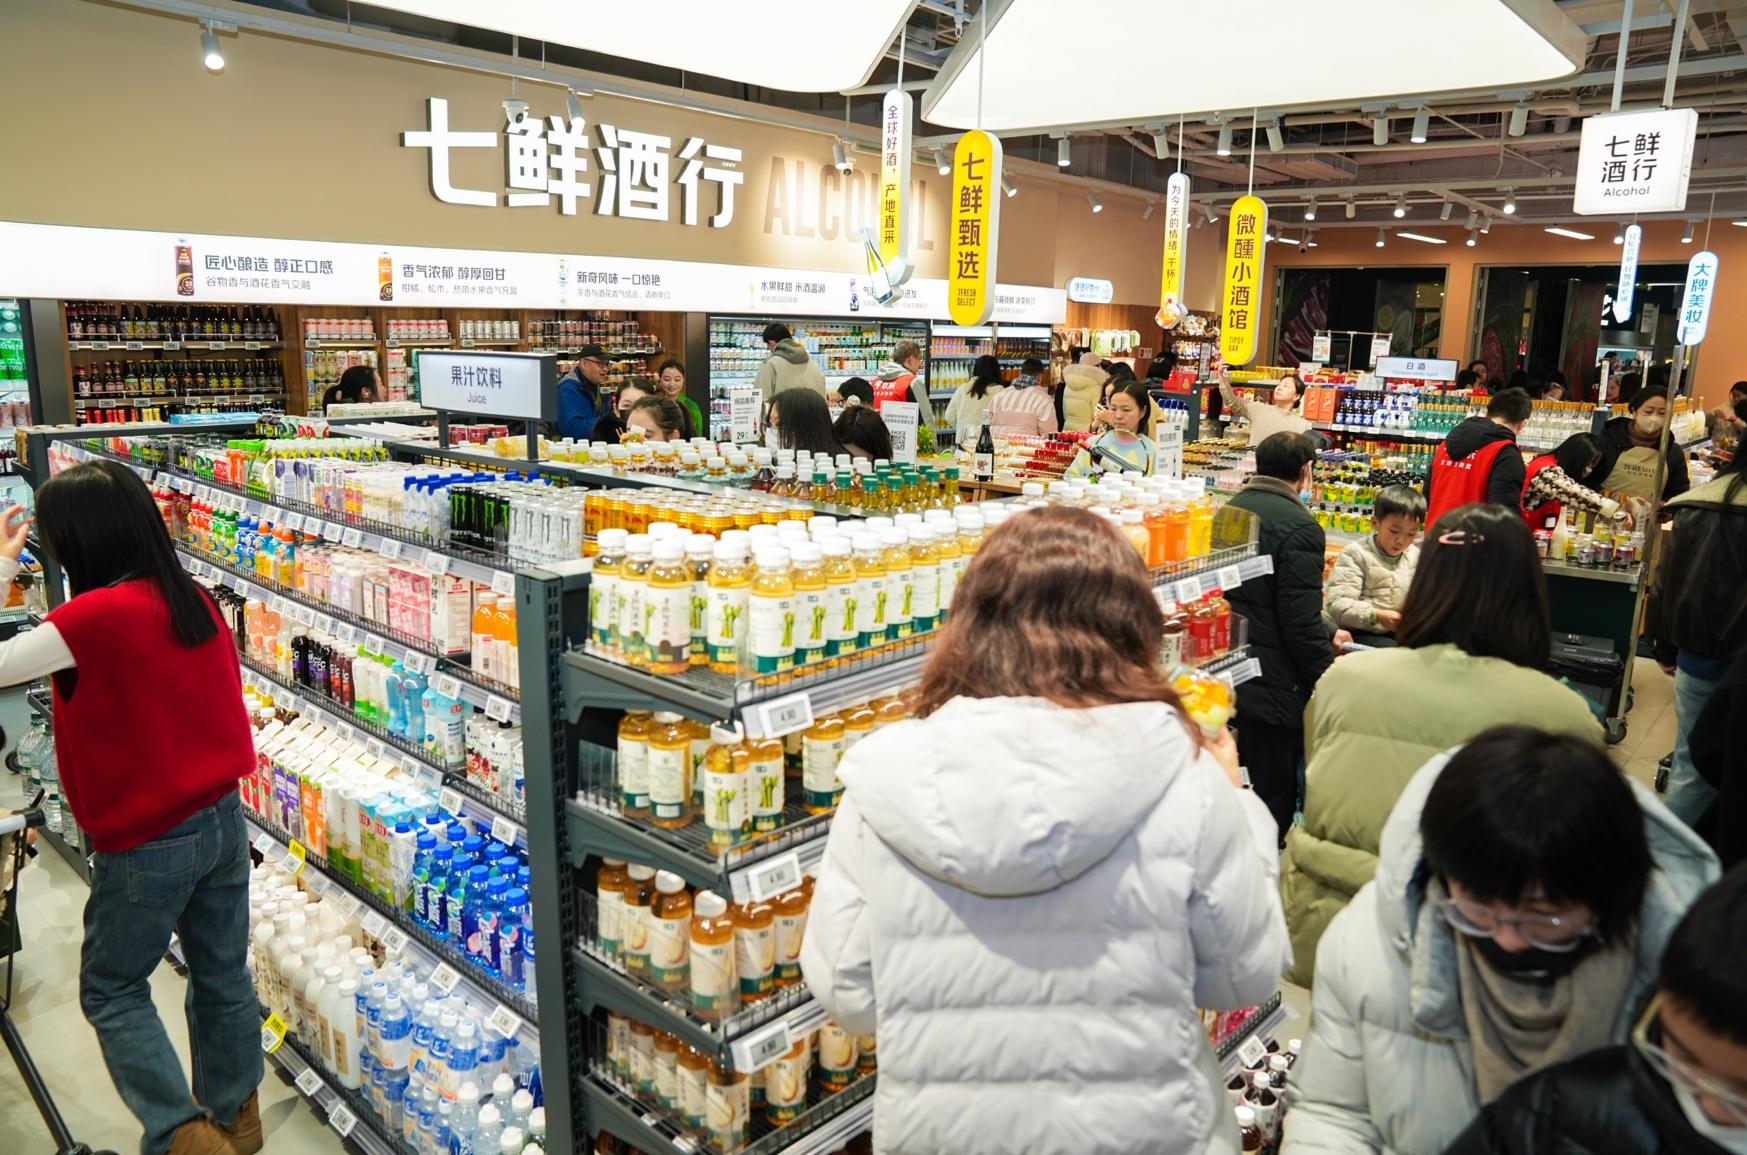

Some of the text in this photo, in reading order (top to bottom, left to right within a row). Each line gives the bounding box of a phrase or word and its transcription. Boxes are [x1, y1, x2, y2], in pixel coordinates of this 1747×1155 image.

[1604, 132, 1660, 158] 七鲜
[401, 97, 744, 229] 七鲜酒行
[1601, 158, 1657, 183] 酒行
[884, 105, 898, 245] 全球好酒，产地直采
[1603, 185, 1650, 197] Alcohol
[764, 156, 934, 251] ALCOL
[957, 152, 985, 280] 七鲜甄选
[1167, 185, 1181, 288] 为今天的情绪，干杯！
[205, 254, 334, 275] 匠心酿造 醇正口感
[402, 264, 506, 281] 香气浓郁 醇厚回甘
[1229, 214, 1256, 330] 微醺小酒馆
[577, 271, 661, 286] 新奇风味 一口惊艳
[760, 280, 793, 293] 水果鲜甜
[957, 288, 976, 297] 7FRESH
[957, 298, 976, 307] SELECT
[1685, 263, 1711, 323] 大牌美妆
[1228, 344, 1239, 353] BAR
[1229, 336, 1244, 345] TIPSY
[451, 365, 503, 389] 果汁饮料
[467, 392, 487, 404] Juice
